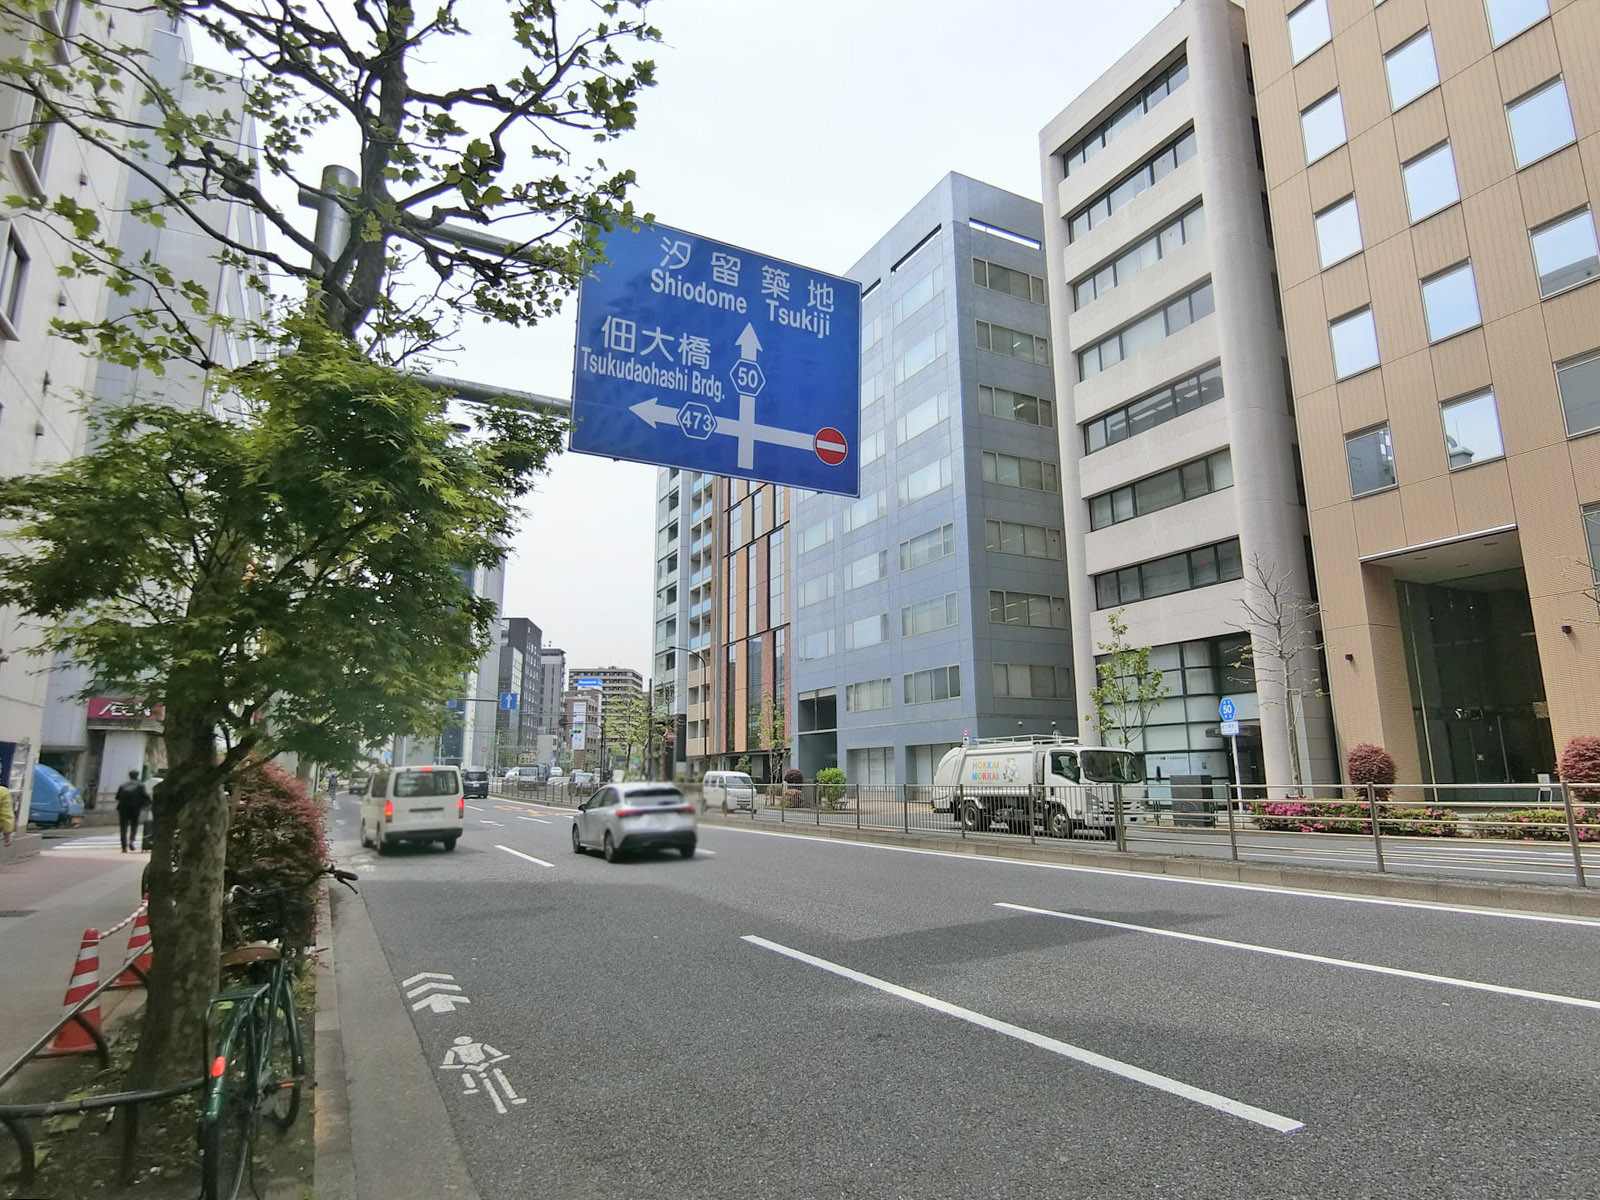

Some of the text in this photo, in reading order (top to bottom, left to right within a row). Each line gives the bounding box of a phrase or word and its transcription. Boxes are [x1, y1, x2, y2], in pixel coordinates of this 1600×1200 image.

[660, 236, 741, 288] 汐留
[650, 268, 748, 315] Shiodome
[765, 298, 831, 339] Tsukiji
[601, 315, 712, 370] 佃大橋
[581, 346, 726, 403] Tsukudaohashi Brdg.
[737, 368, 758, 389] 50
[681, 410, 712, 432] 473
[1222, 704, 1233, 714] 50
[972, 760, 1000, 770] HOKKAI
[972, 771, 1000, 781] MOKKAI
